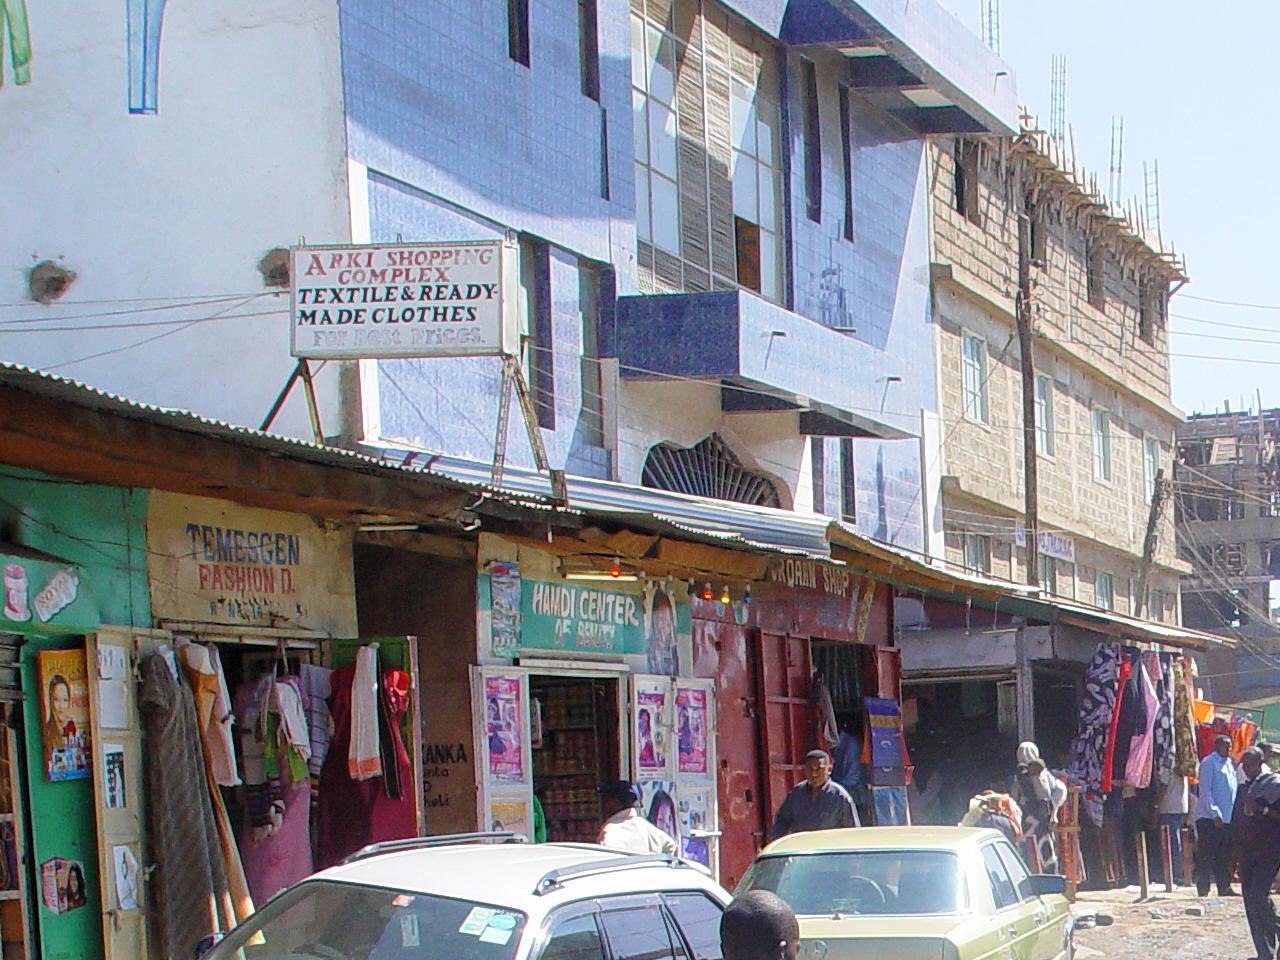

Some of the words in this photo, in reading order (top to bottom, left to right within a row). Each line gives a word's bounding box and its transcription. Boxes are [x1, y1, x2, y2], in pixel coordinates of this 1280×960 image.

[386, 248, 494, 268] SHOPPING
[338, 267, 451, 285] COMPLEX
[298, 286, 399, 304] TEXTILE
[400, 286, 415, 302] &
[297, 308, 366, 326] MADE
[372, 306, 477, 325] CLOTHES
[184, 523, 300, 565] TEMESGEN
[198, 564, 275, 595] FASHION
[531, 583, 576, 619] HAMDI
[579, 590, 640, 627] CENTER
